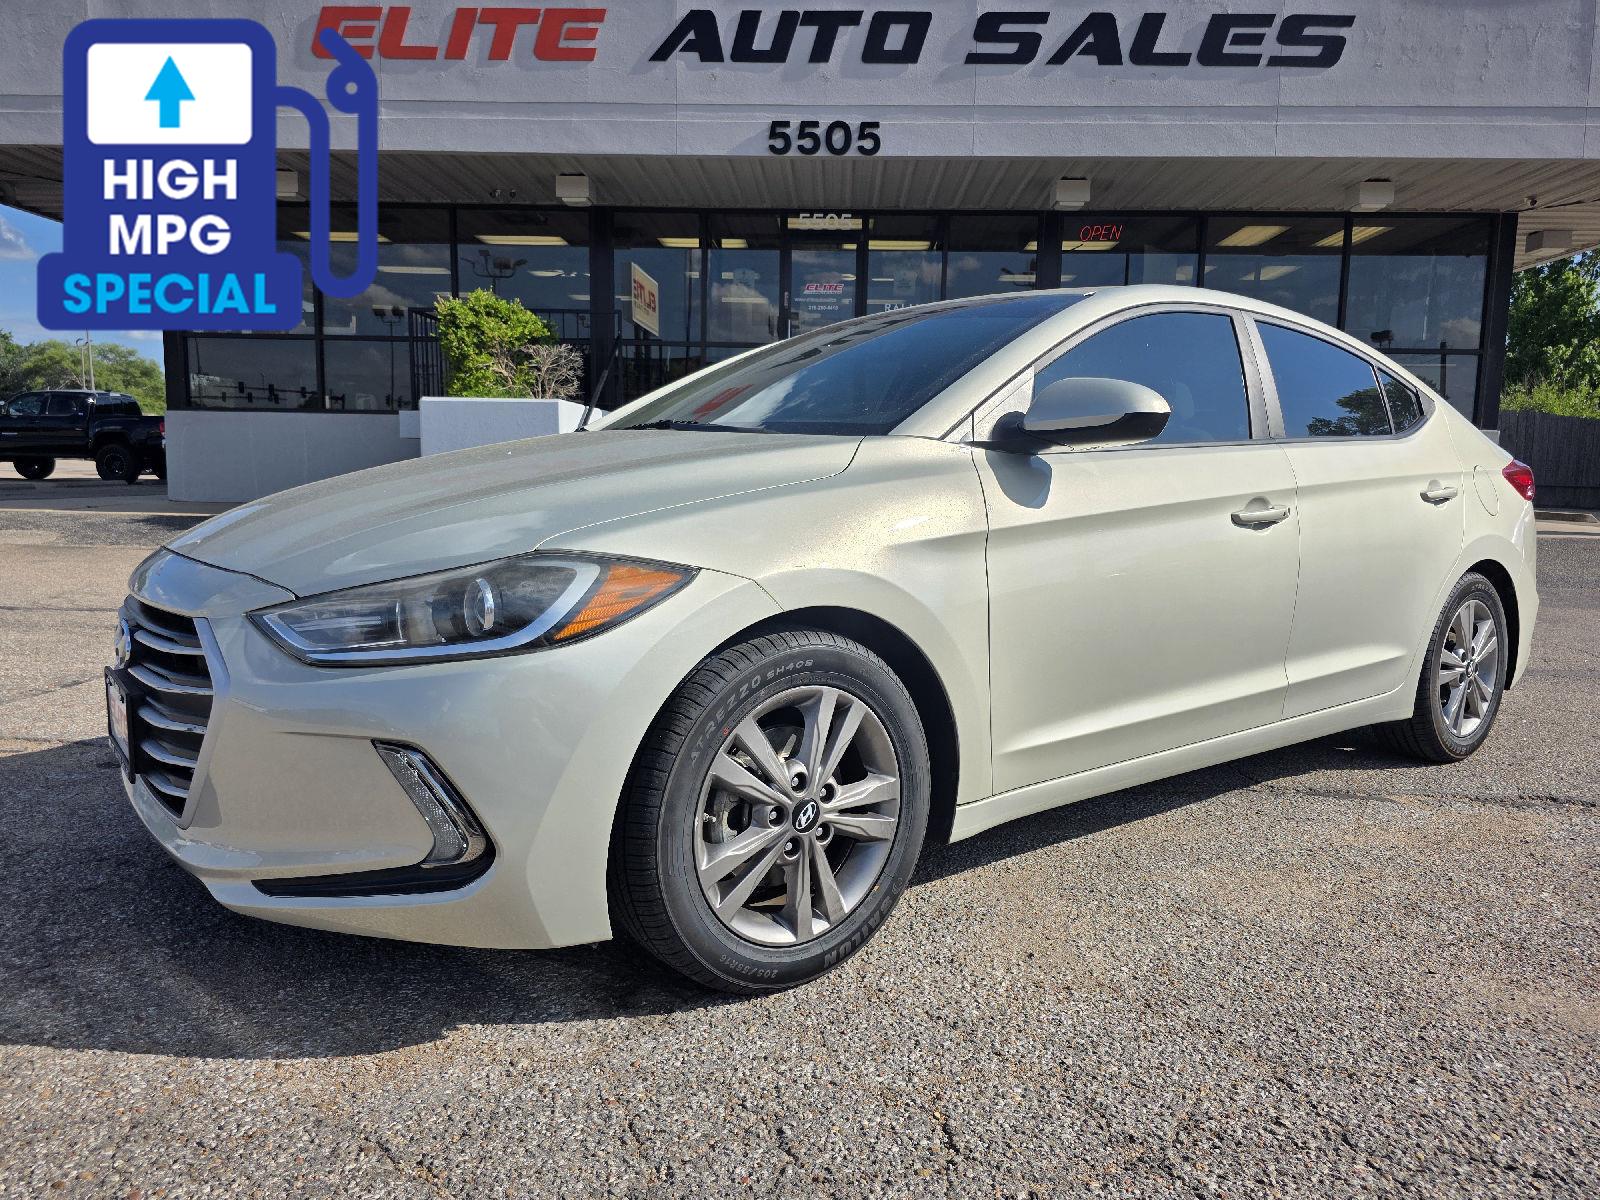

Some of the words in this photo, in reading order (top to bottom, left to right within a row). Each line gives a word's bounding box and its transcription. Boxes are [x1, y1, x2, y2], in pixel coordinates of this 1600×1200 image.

[311, 7, 606, 61] ELITE
[649, 10, 932, 63] AUTO
[964, 12, 1356, 68] SALES
[768, 121, 881, 156] 5505
[1080, 225, 1123, 242] OPEN
[804, 283, 845, 292] ELITE
